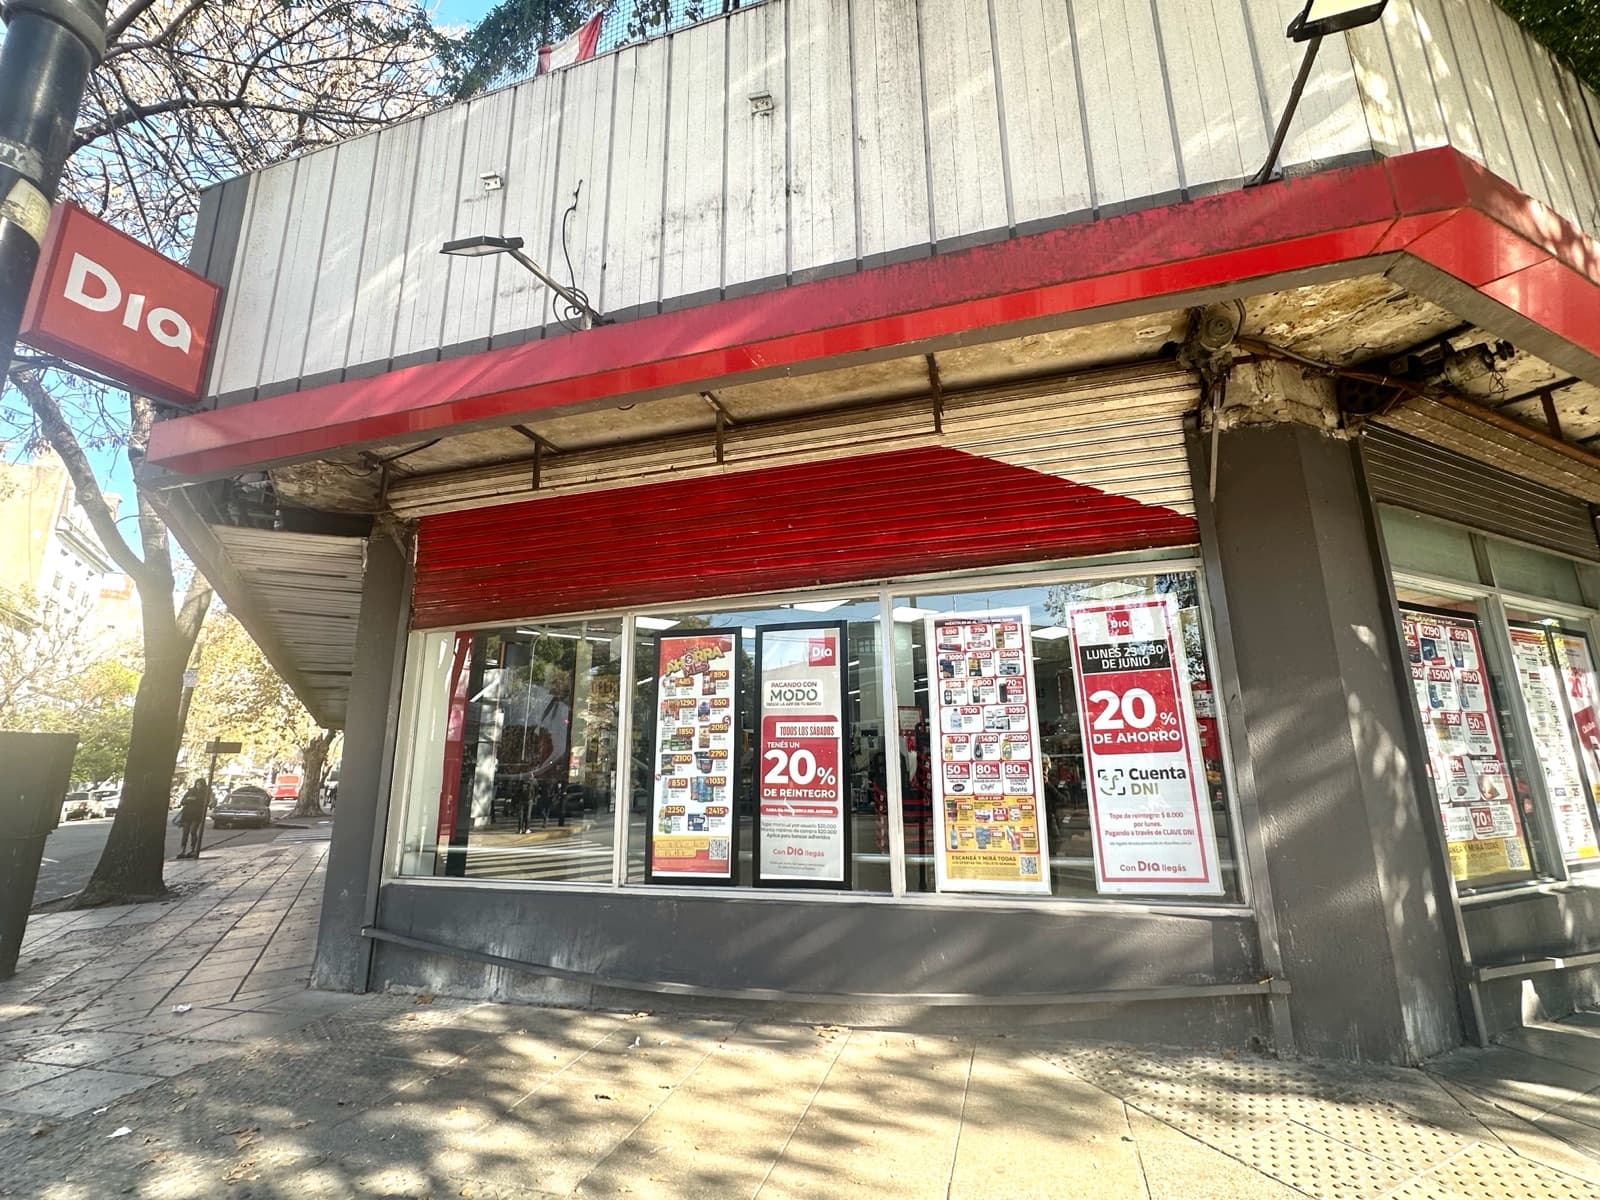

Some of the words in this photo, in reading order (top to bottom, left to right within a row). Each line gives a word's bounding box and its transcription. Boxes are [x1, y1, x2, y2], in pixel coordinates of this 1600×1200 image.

[64, 251, 192, 354] Dia
[1086, 648, 1122, 660] LUNES
[1140, 646, 1147, 655] Y
[1150, 644, 1164, 655] 30
[1101, 659, 1117, 669] DE
[1118, 656, 1151, 669] JUNIO
[770, 689, 818, 702] MODO
[1088, 687, 1177, 730] 20%
[780, 726, 798, 737] TODOS
[798, 726, 809, 737] LOS
[1093, 733, 1113, 744] DE
[1116, 729, 1181, 744] AHORRO
[767, 740, 789, 749] TENÉS
[789, 741, 801, 749] UN
[763, 748, 836, 786] 20%
[1128, 767, 1187, 781] Cuenta
[763, 788, 778, 798] DE
[780, 788, 836, 799] REINTEGRO
[1131, 782, 1159, 796] DNI
[1120, 864, 1136, 872] Con
[1137, 860, 1160, 872] Dia
